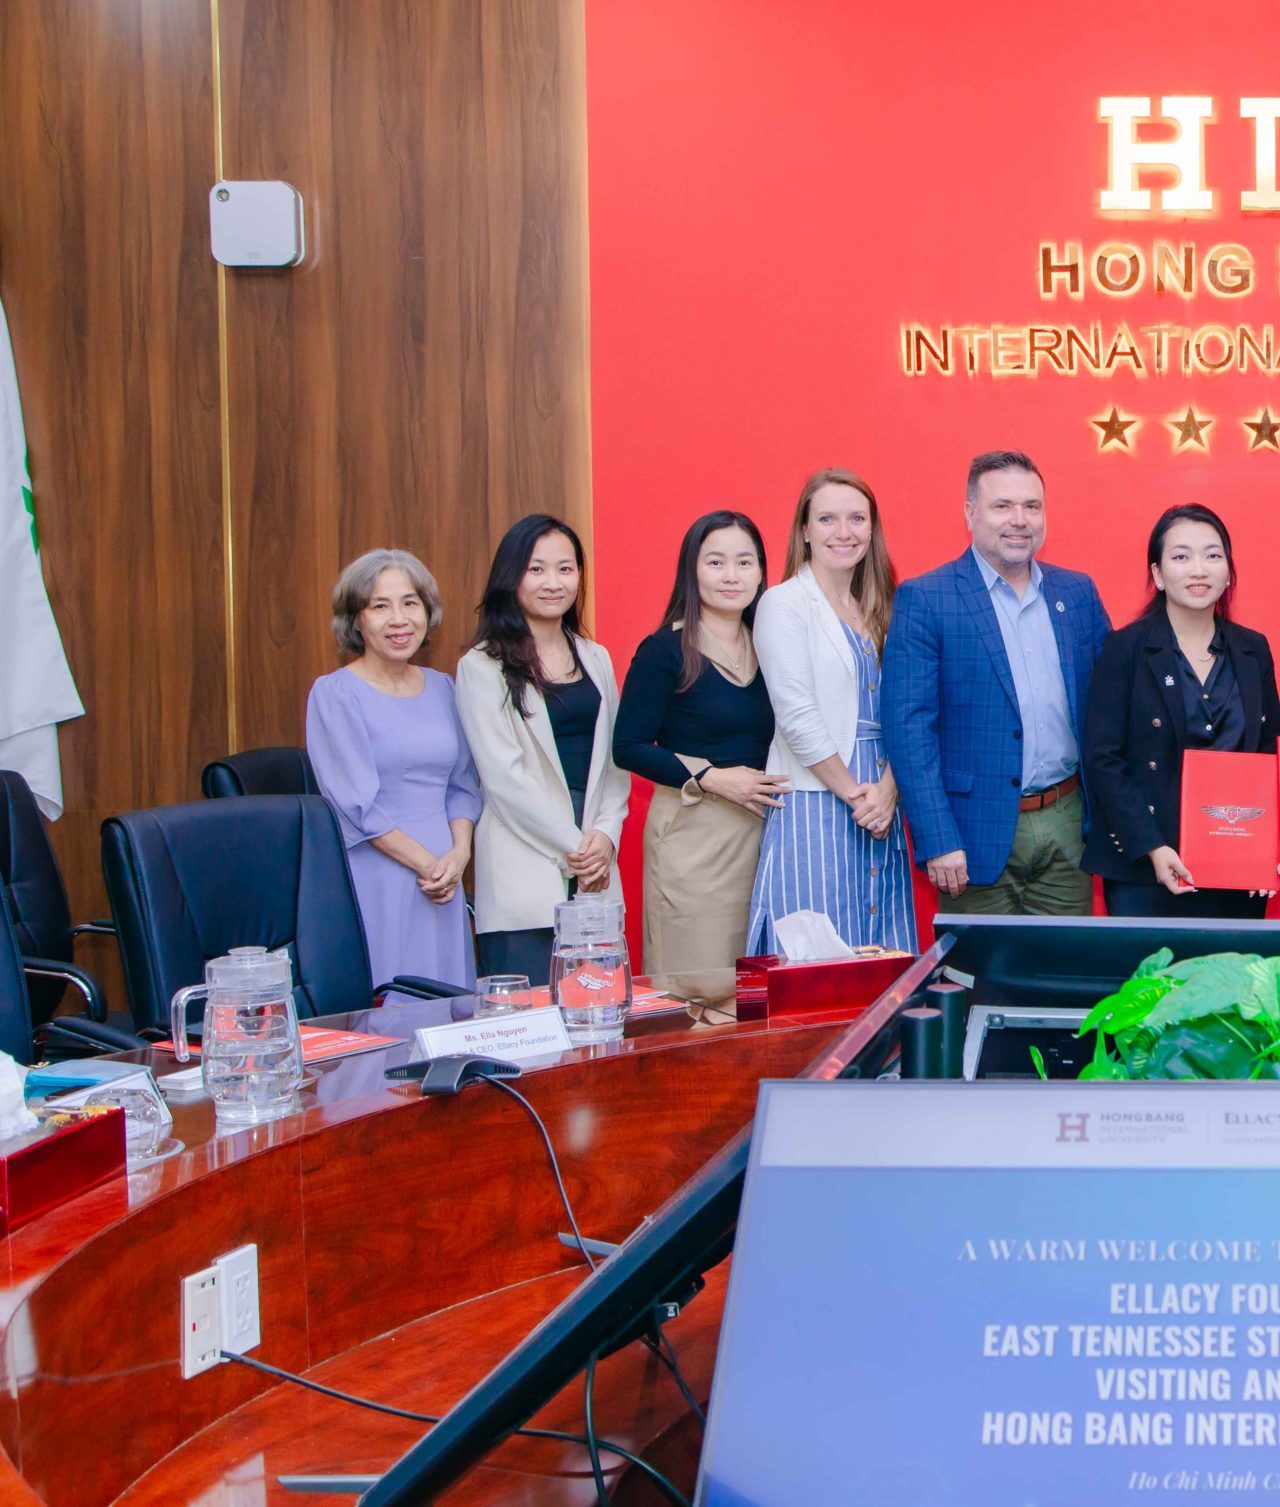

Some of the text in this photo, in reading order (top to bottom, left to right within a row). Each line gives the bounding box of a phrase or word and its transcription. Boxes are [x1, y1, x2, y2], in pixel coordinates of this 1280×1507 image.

[1040, 245, 1253, 295] HONG
[480, 1031, 496, 1040] Ella
[497, 1026, 528, 1038] Nguyen
[520, 1034, 558, 1046] Foundation
[957, 1240, 977, 1261] A
[988, 1240, 1087, 1261] WARM
[1098, 1240, 1262, 1261] WELCOME
[1109, 1283, 1220, 1315] ELLACY
[983, 1325, 1058, 1357] EAST
[1069, 1326, 1236, 1358] TENNESSEE
[1096, 1369, 1231, 1401] VISITING
[982, 1412, 1073, 1445] HONG
[1084, 1413, 1173, 1446] BANG
[1128, 1471, 1158, 1490] Ho
[1163, 1470, 1199, 1490] Chi
[1203, 1470, 1257, 1490] Minh
